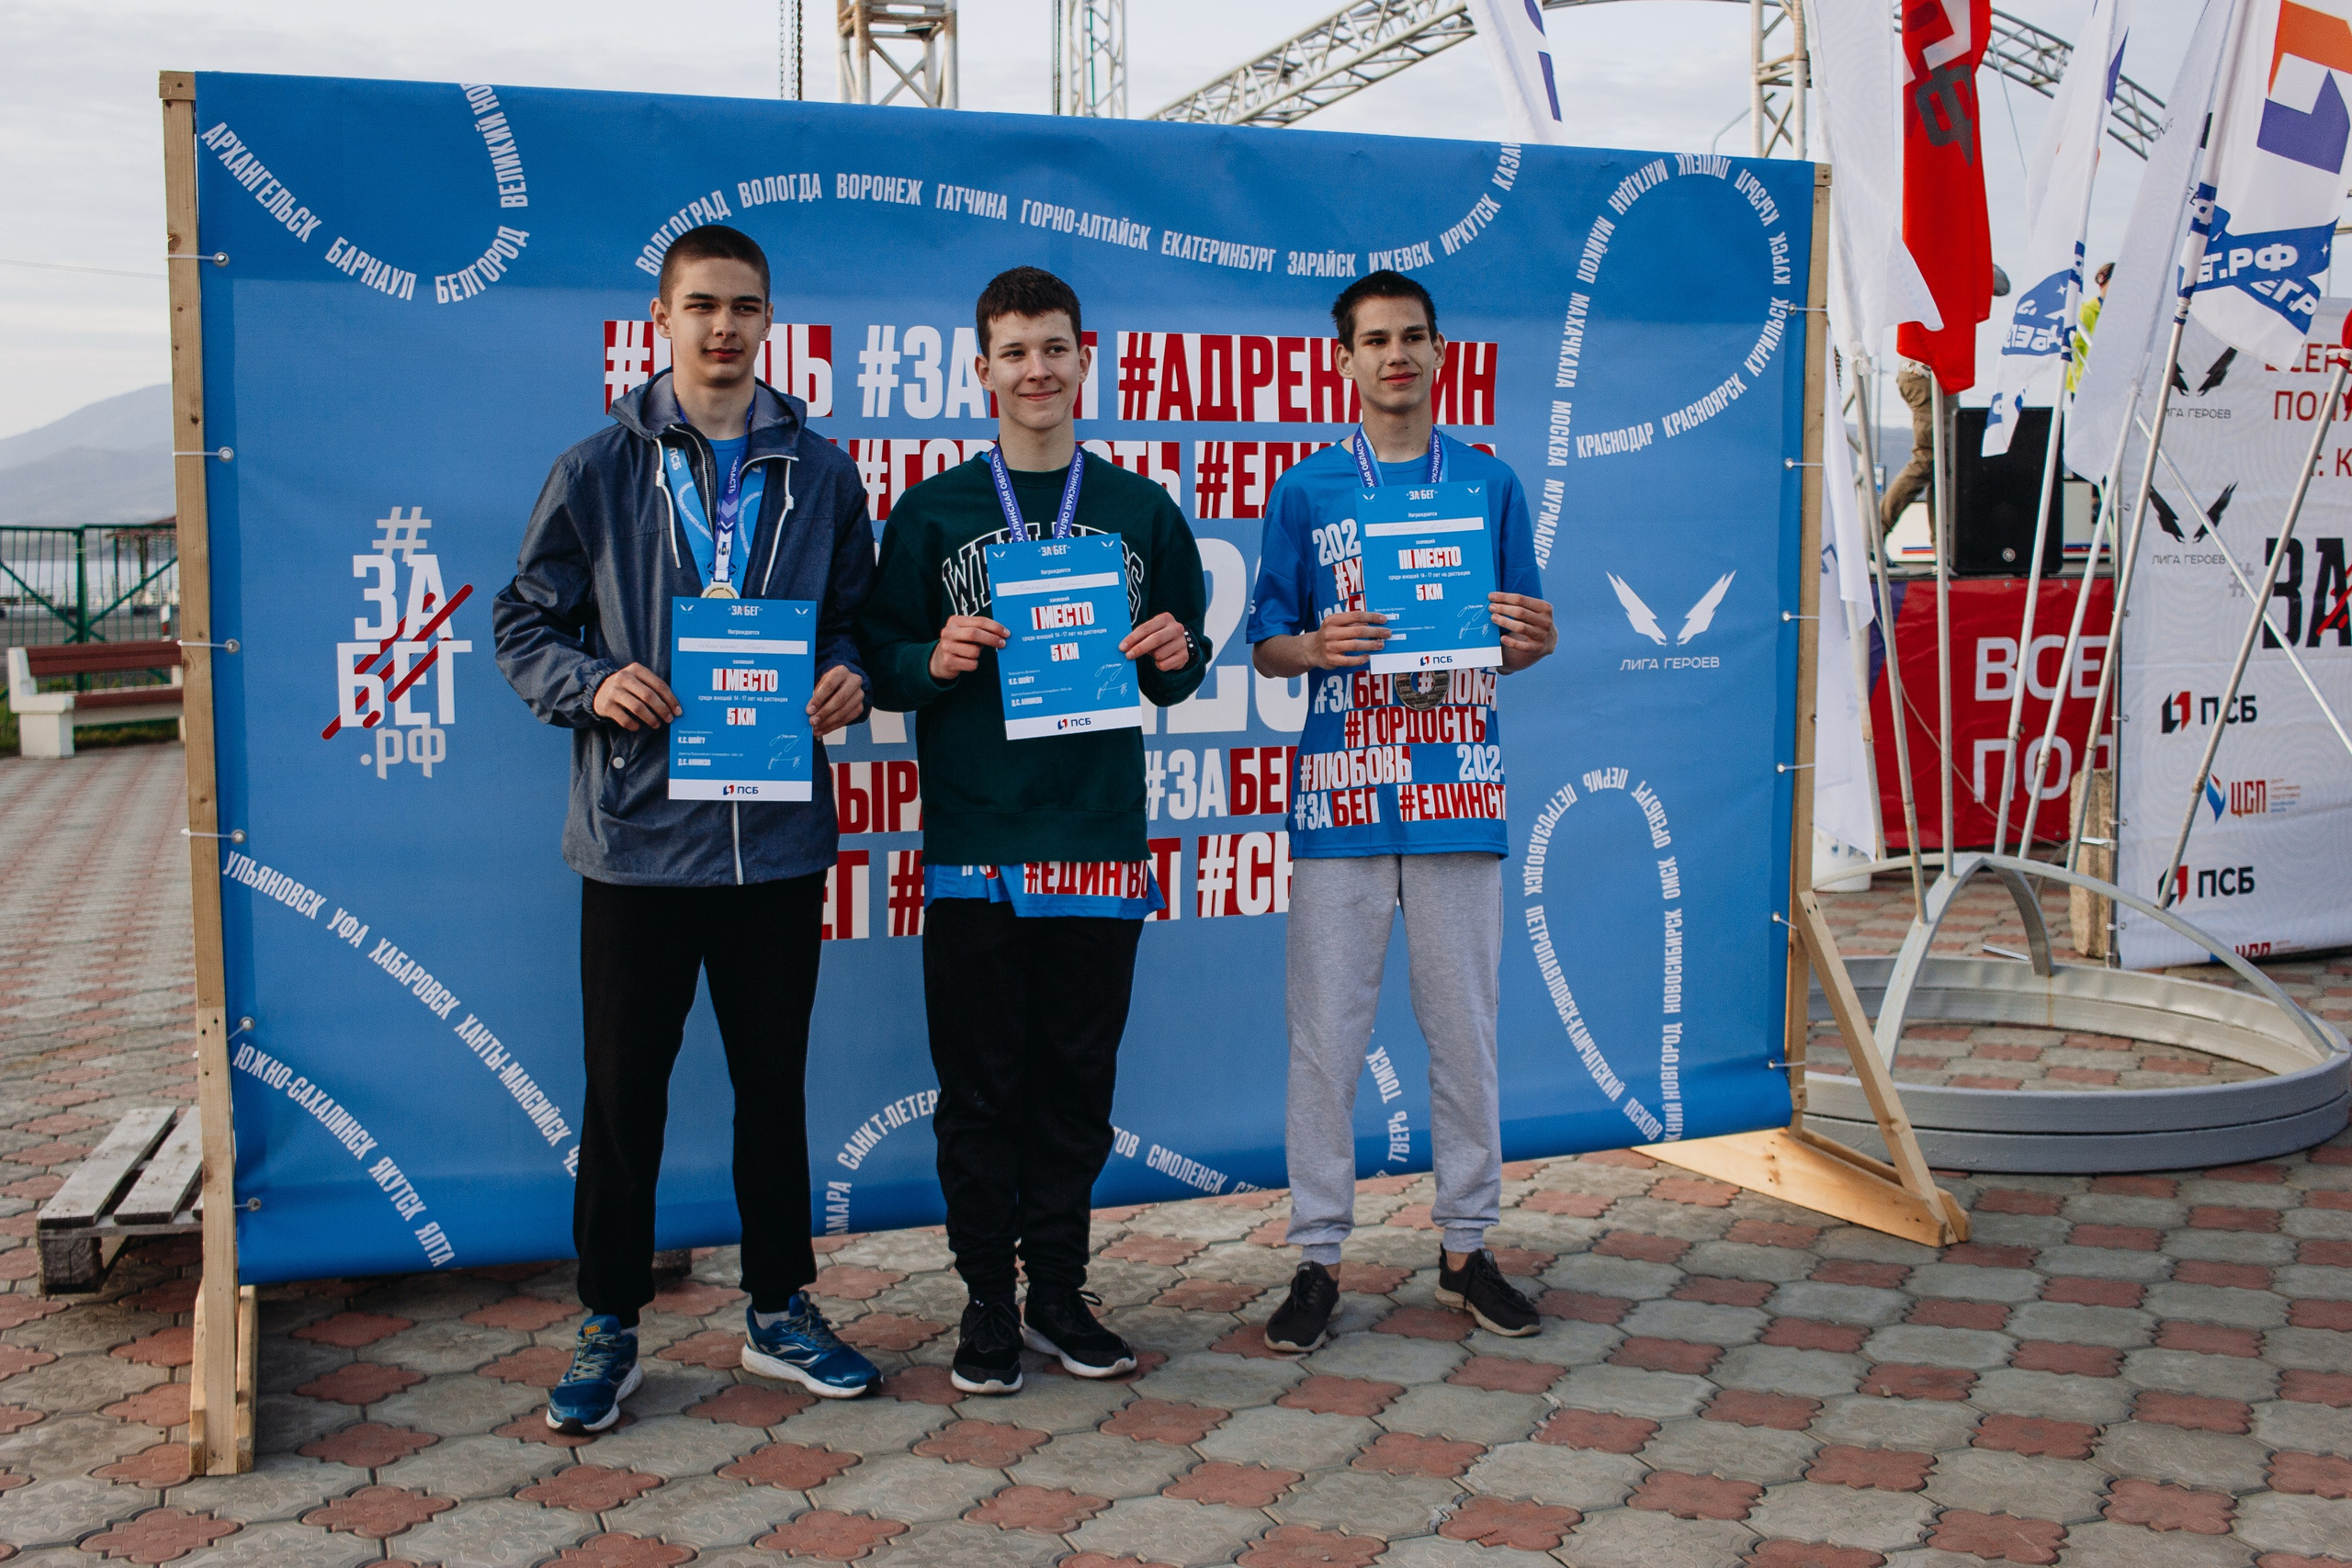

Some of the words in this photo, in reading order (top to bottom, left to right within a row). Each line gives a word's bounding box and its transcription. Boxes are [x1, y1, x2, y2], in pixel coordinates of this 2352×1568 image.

[459, 83, 501, 116] НО
[201, 121, 322, 243] АРХАНГЕЛЬСК
[474, 111, 529, 208] ВЕЛИКИЙ
[1608, 158, 1669, 217] МАГАДАН
[1674, 153, 1732, 181] ЛИПЕЦК
[635, 190, 732, 276] ВОЛГОГРАД
[738, 173, 823, 209] ВОЛОГДА
[836, 173, 923, 206] ВОРОНЕЖ
[935, 184, 1008, 220] ГАТЧИНА
[1020, 198, 1151, 251] ГОРНО-АЛТАЙСК
[1161, 231, 1277, 273] ЕКАТЕРИНБУРГ
[1287, 250, 1357, 277] ЗАРАЙСК
[1368, 241, 1435, 274] ИЖЕВСК
[1439, 193, 1501, 256] ИРКУТСК
[1734, 168, 1781, 228] КЫЗЫЛ
[324, 236, 417, 301] БАРНАУЛ
[435, 225, 530, 304] БЕЛГОРОД
[1576, 215, 1617, 285] МАЙКОП
[1768, 231, 1792, 286] КУРСК
[1555, 292, 1591, 389] МАХАЧКАЛА
[1744, 296, 1790, 378] КУРИЛЬСК
[1546, 400, 1573, 467] МОСКВА
[1662, 372, 1747, 439] КРАСНОЯРСК
[2188, 408, 2232, 420] ГЕРОЕВ
[1576, 422, 1654, 458] КРАСНОДАР
[993, 453, 1009, 490] ОБЛАСТЬ
[1065, 452, 1083, 511] САХАЛИНСКАЯ
[1532, 479, 1566, 570] МУРМАНСК
[1040, 568, 1071, 576] Награждается
[1414, 546, 1463, 569] МЕСТО
[2152, 554, 2181, 565] ЛИГА
[2184, 554, 2226, 566] ГЕРОЕВ
[353, 554, 455, 640] ЗА
[1038, 601, 1095, 630] МЕСТО
[337, 640, 473, 728] БЕГ
[725, 668, 779, 693] МЕСТО
[1432, 655, 1453, 664] ПСБ
[1620, 659, 1659, 671] ЛИГА
[1665, 656, 1720, 670] ГЕРОЕВ
[1070, 717, 1091, 728] ПСБ
[1345, 705, 1487, 749] #ГОРДОСТЬ
[737, 786, 759, 795] ПСБ
[1300, 745, 1413, 792] #ЛЮБОВЬ
[1582, 767, 1629, 793] ПЕРМЬ
[1295, 786, 1380, 830] #ЗАБЕГ
[1631, 780, 1672, 849] ОРЕНБУРГ
[1522, 783, 1578, 897] ПЕТРОЗАВОДСК
[1657, 855, 1681, 900] ОМСК
[2197, 865, 2256, 899] ПСБ
[1663, 908, 1683, 1013] НОВОСИБИРСК
[223, 851, 327, 919] УЛЬЯНОВСК
[326, 908, 369, 948] УФА
[368, 938, 460, 1021] ХАБАРОВСК
[454, 1013, 571, 1147] ХАНТЫ-МАНСИЙСК
[1525, 905, 1626, 1102] ПЕТРОПАВЛОВСК-КАМЧАТСКИЙ
[1365, 1045, 1403, 1104] ТОМСК
[1660, 1022, 1683, 1100] НОВГОРОД
[837, 1088, 942, 1171] САНКТ-ПЕТЕР
[1387, 1110, 1410, 1163] ТВЕРЬ
[1623, 1096, 1664, 1142] ПСКОВ
[232, 1043, 378, 1161] ЮЖНО-САХАЛИНСК
[368, 1156, 427, 1223] ЯКУТСК
[414, 1221, 456, 1269] ЯЛТА
[1146, 1144, 1229, 1194] СМОЛЕНСК
